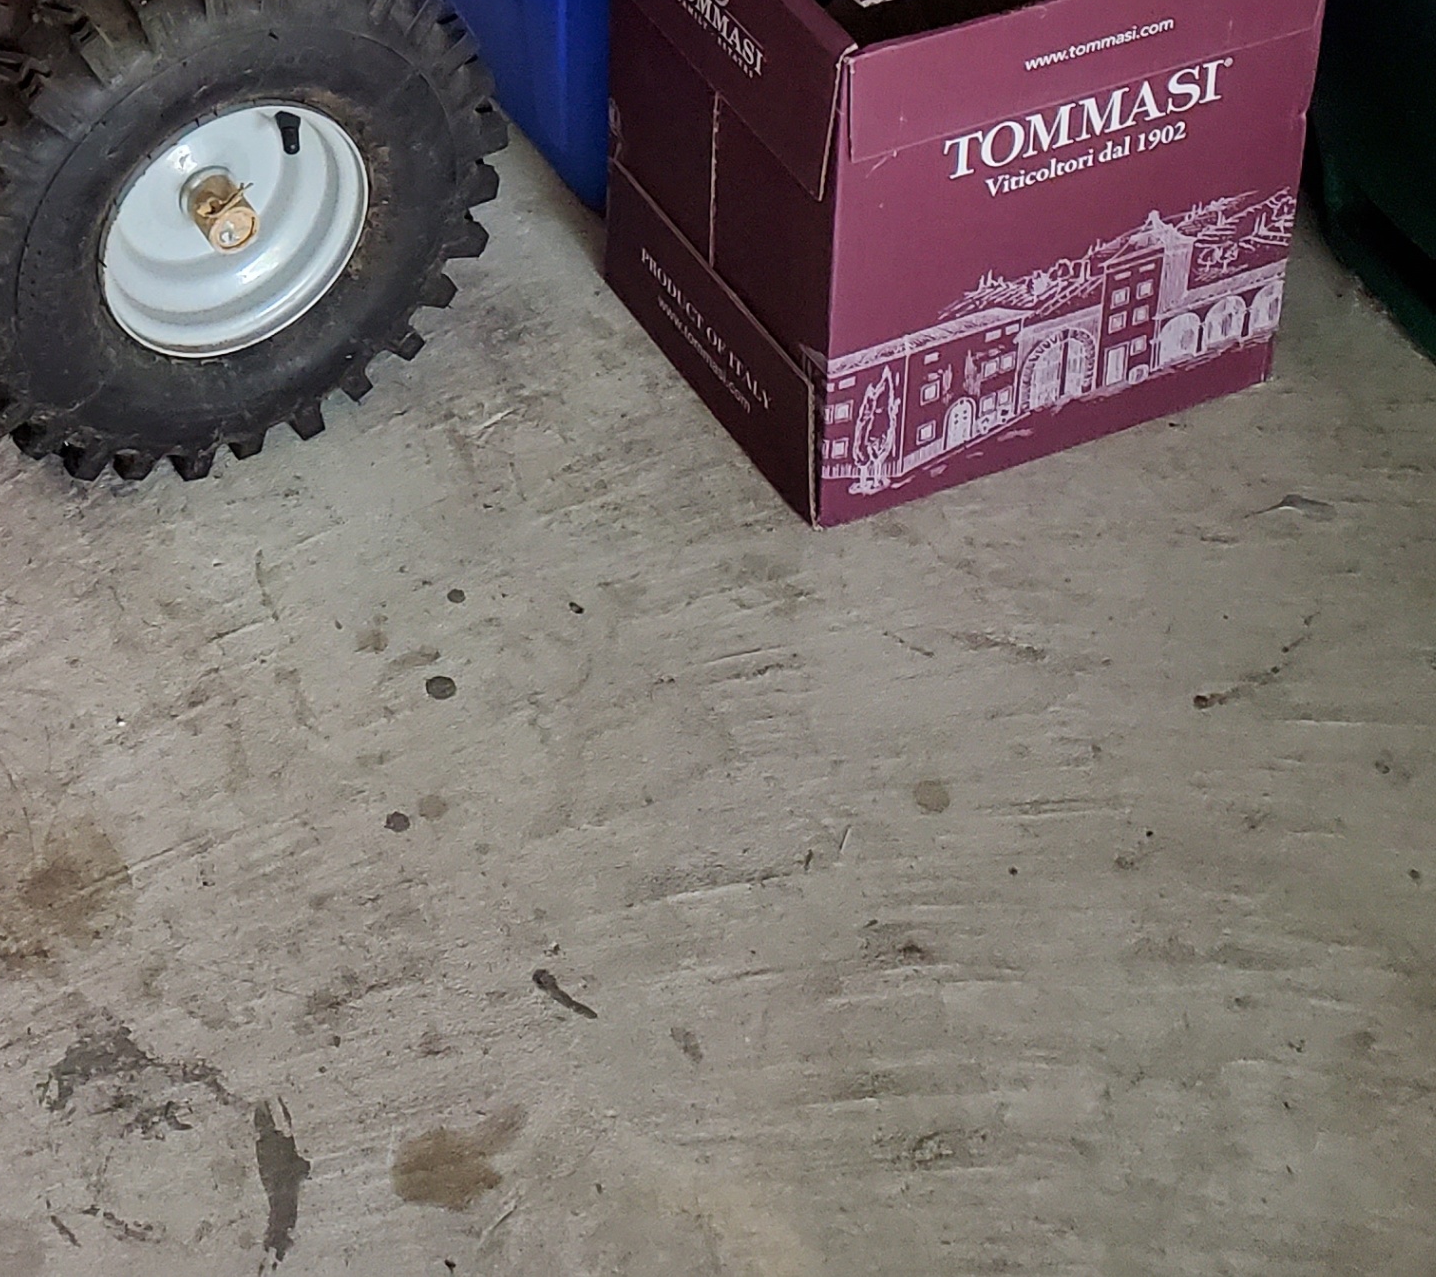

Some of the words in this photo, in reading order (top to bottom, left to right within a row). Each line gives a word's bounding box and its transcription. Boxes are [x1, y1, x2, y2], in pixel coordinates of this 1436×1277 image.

[1024, 17, 1175, 72] www.tommasi.com
[943, 58, 1226, 180] TOMMASI
[985, 148, 1094, 198] Viticoltori
[1098, 135, 1132, 164] dal
[1137, 121, 1187, 153] 1902
[640, 246, 705, 330] PRODUCT
[706, 326, 727, 355] OF
[727, 350, 772, 410] ITALY
